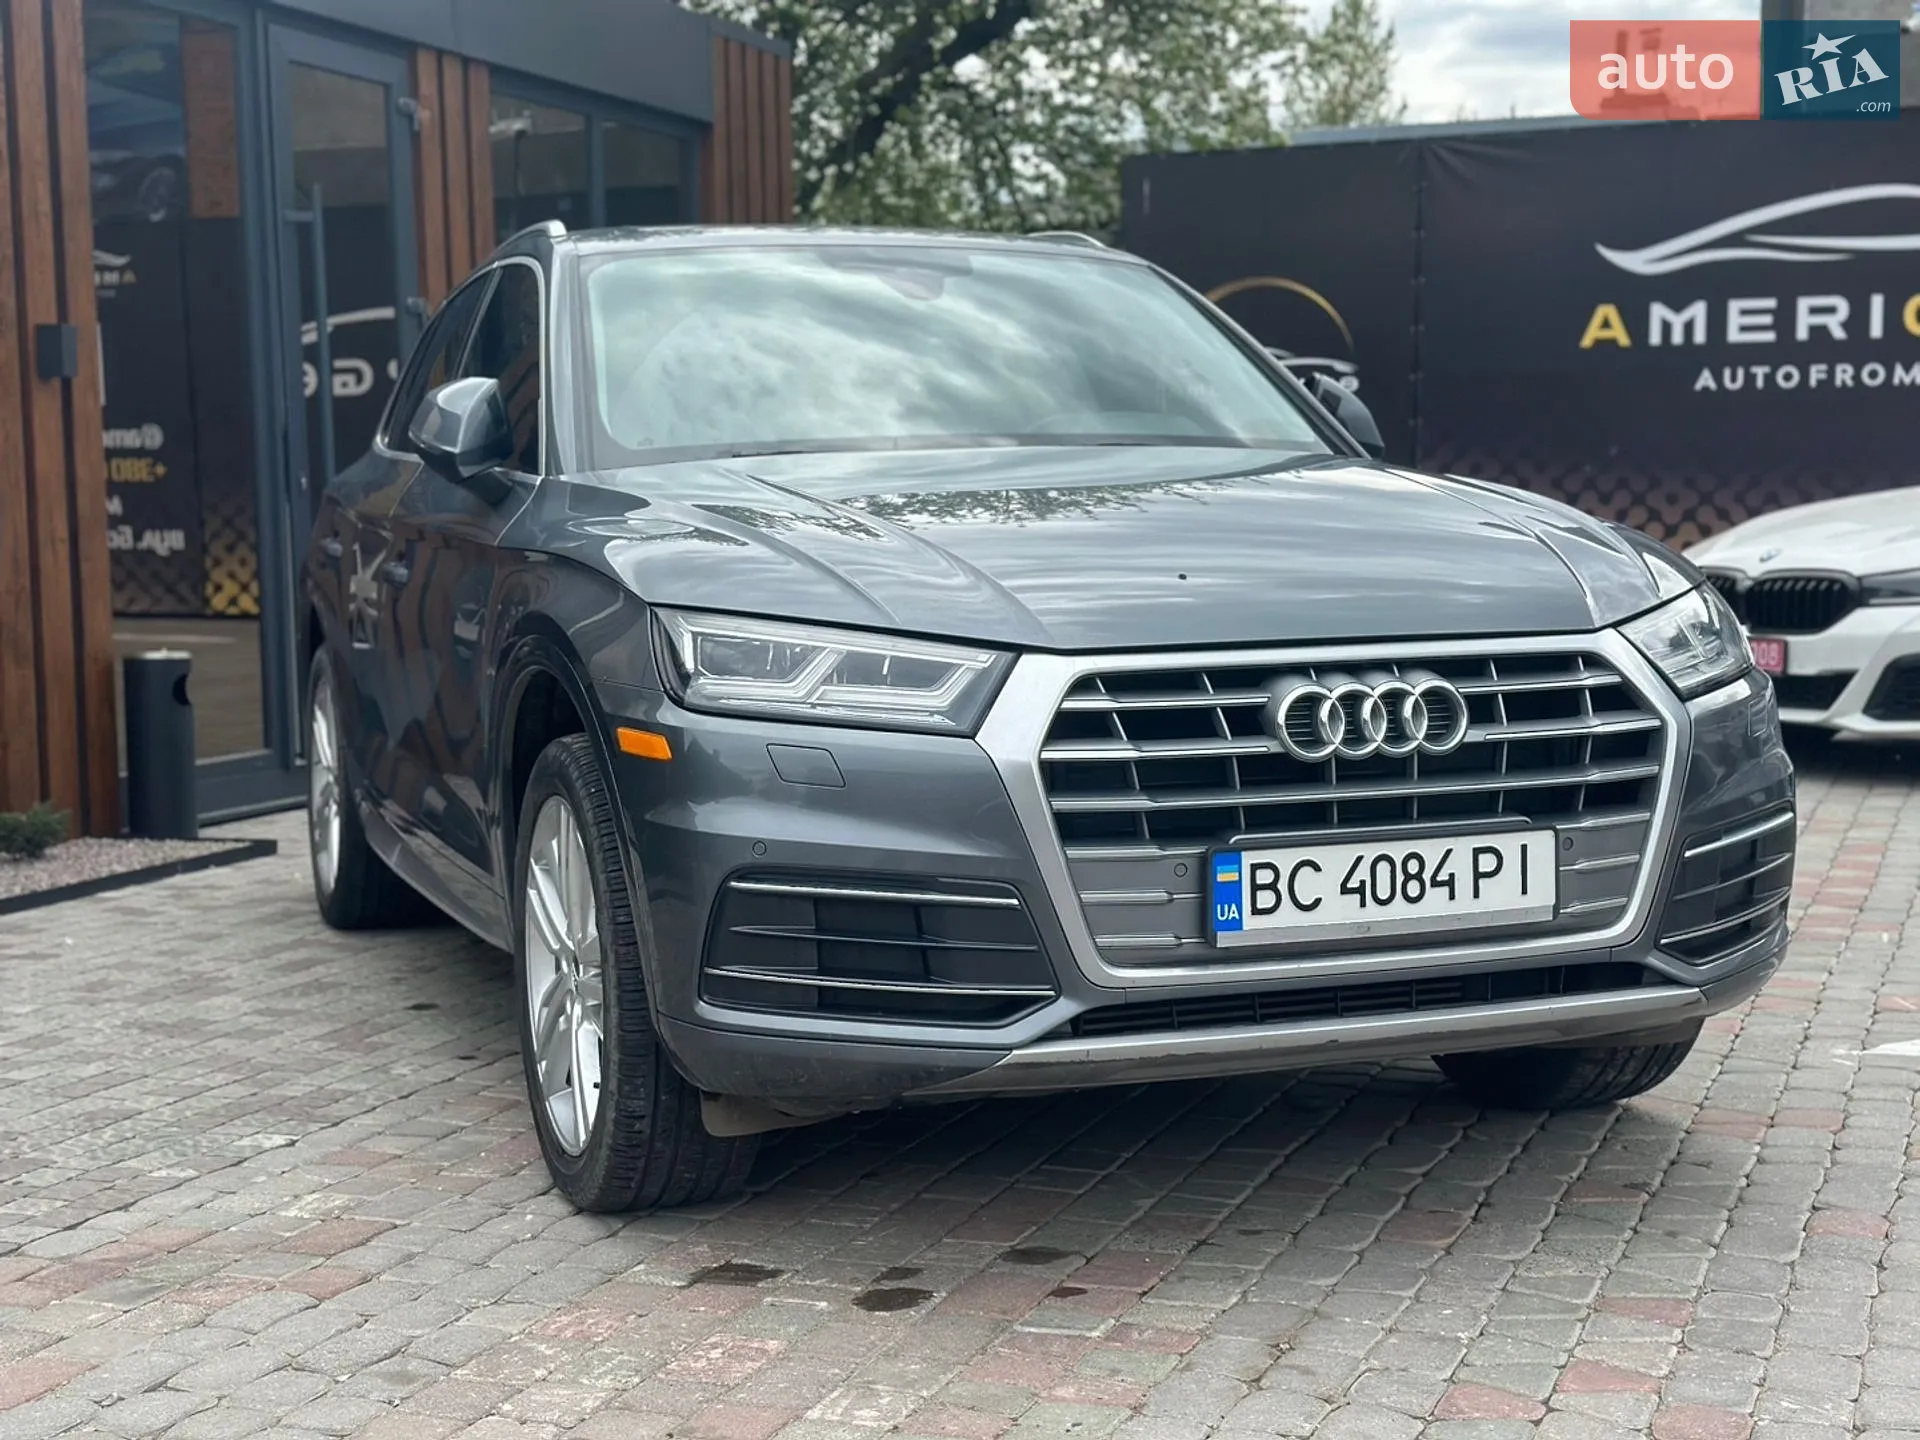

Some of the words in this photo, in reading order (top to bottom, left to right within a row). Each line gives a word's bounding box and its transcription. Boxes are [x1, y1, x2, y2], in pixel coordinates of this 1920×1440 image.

[1693, 361, 1920, 392] AUTOFROM
[1250, 859, 1322, 915] BC
[1340, 848, 1455, 907] 4084
[1217, 903, 1240, 920] UA
